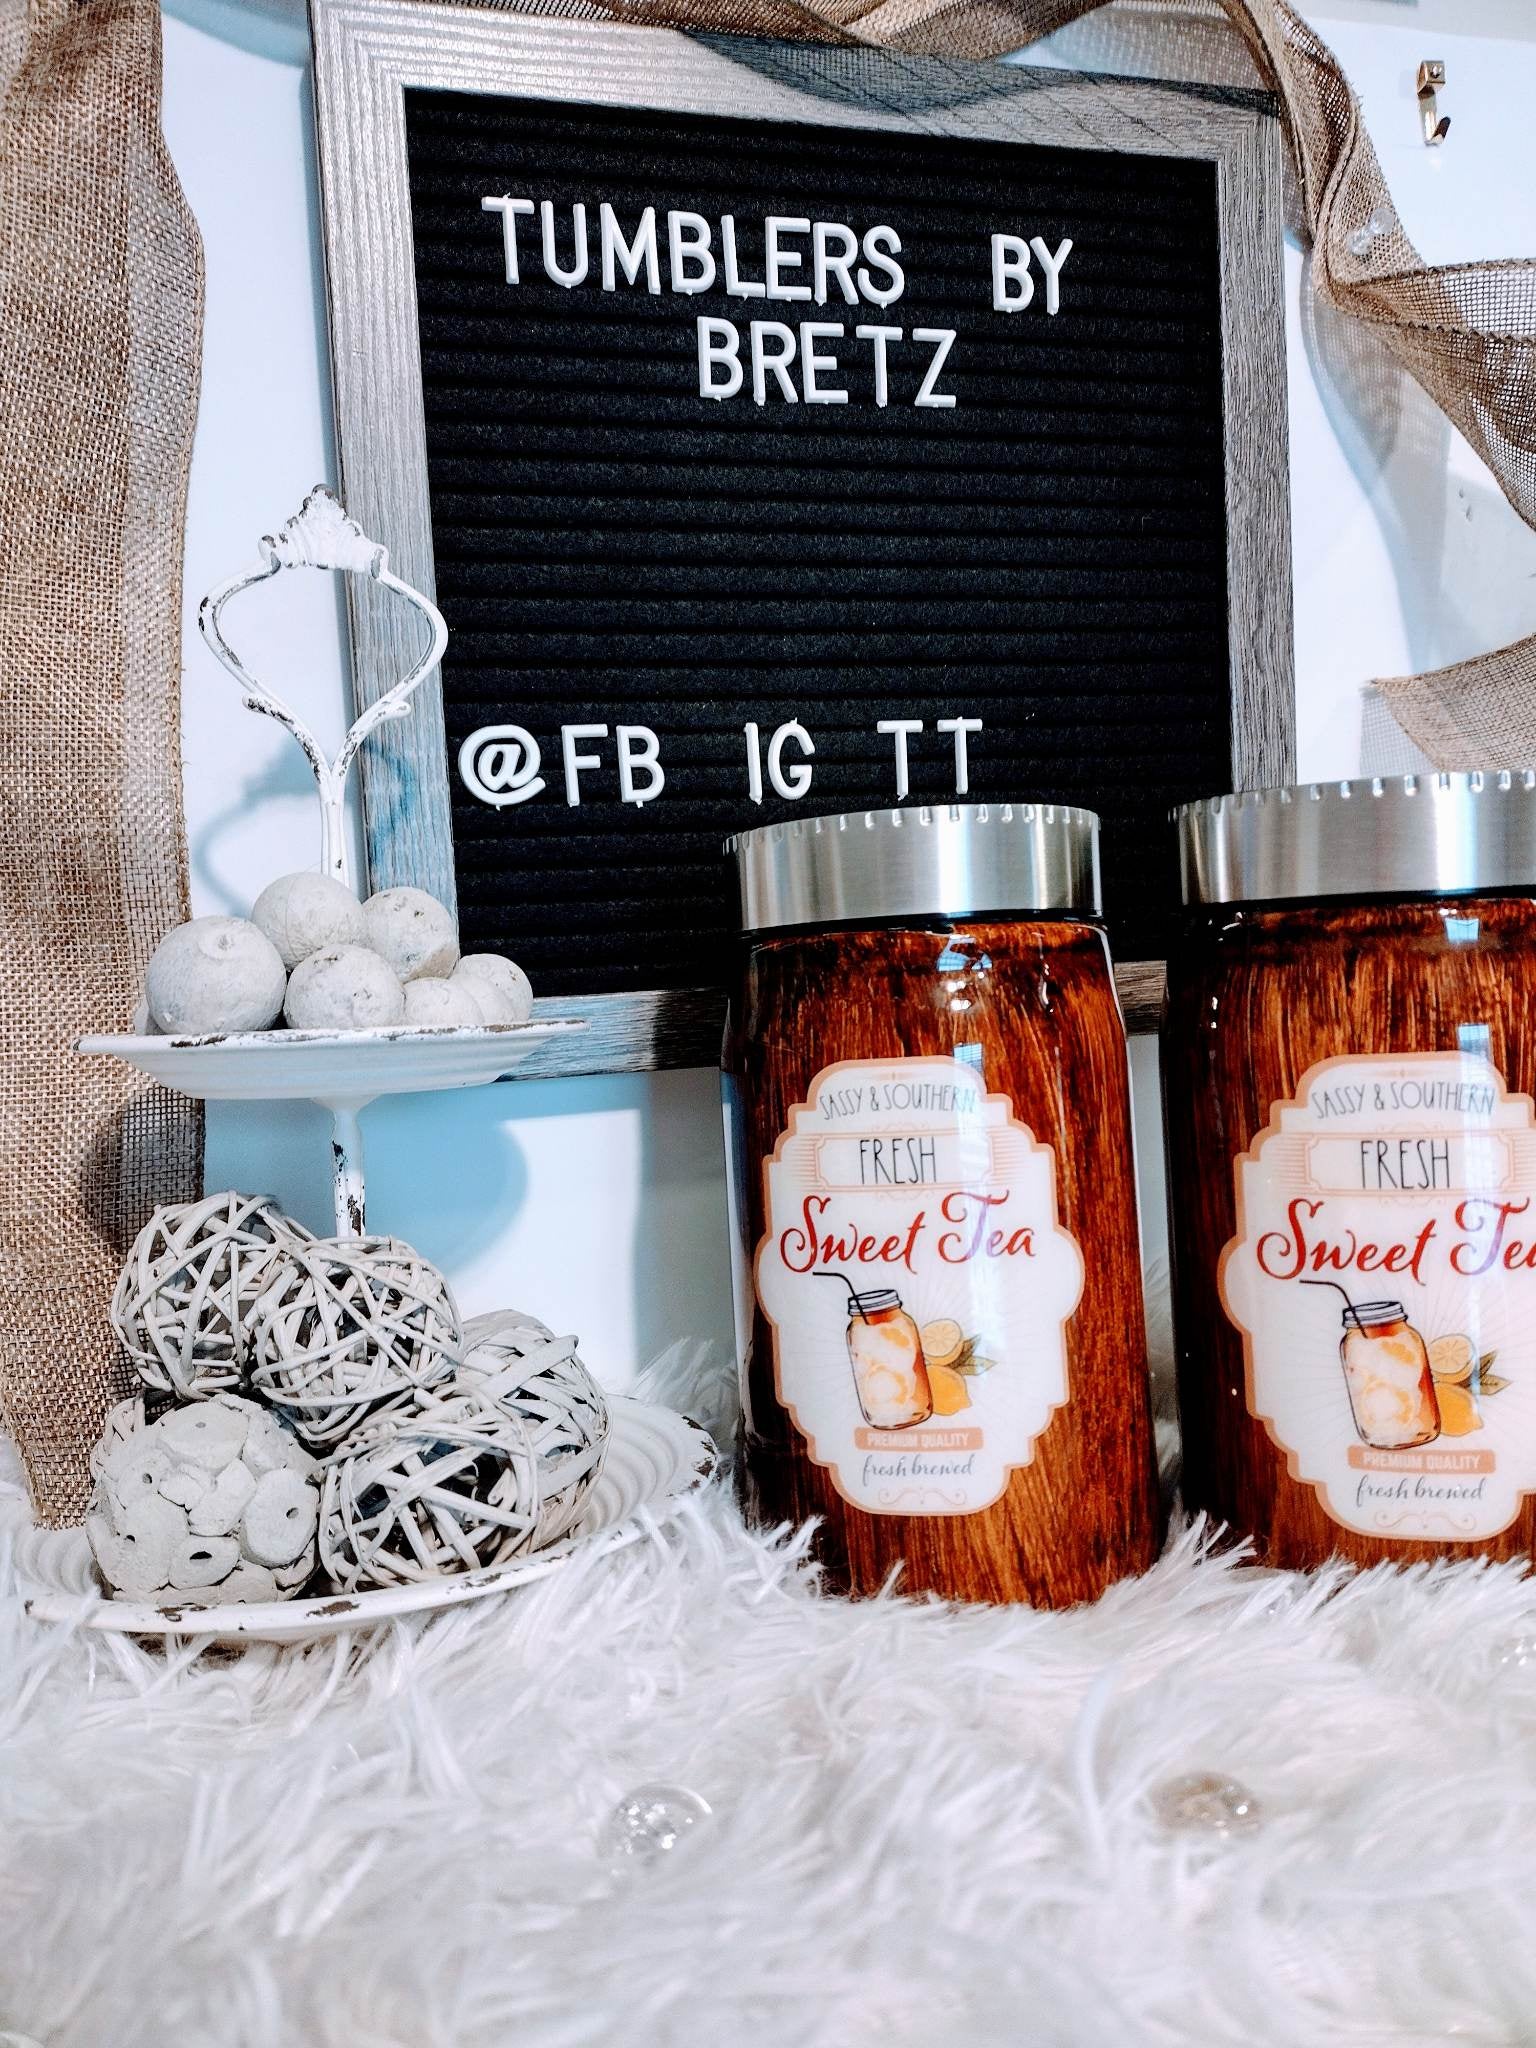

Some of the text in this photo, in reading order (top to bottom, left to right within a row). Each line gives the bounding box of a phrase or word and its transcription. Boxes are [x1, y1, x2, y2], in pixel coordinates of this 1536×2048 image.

[482, 193, 1074, 316] TUMBLERS BY
[696, 315, 957, 408] BRETZ
[743, 717, 816, 805] IG
[876, 716, 983, 800] TT
[819, 1083, 976, 1120] SASSY & SOUTHERN
[1311, 1081, 1495, 1119] SASSY & SOUTHERN
[858, 1136, 938, 1185] FRESH
[1360, 1138, 1451, 1190] FRESH
[780, 1189, 1039, 1275] Sweet Tea
[1256, 1198, 1438, 1286] Sweet
[866, 1432, 969, 1448] PREMIUM QUALITY
[1362, 1451, 1482, 1471] PREMIUM QUALITY
[862, 1453, 976, 1487] fresh brewed
[1356, 1474, 1487, 1508] fresh brewed
